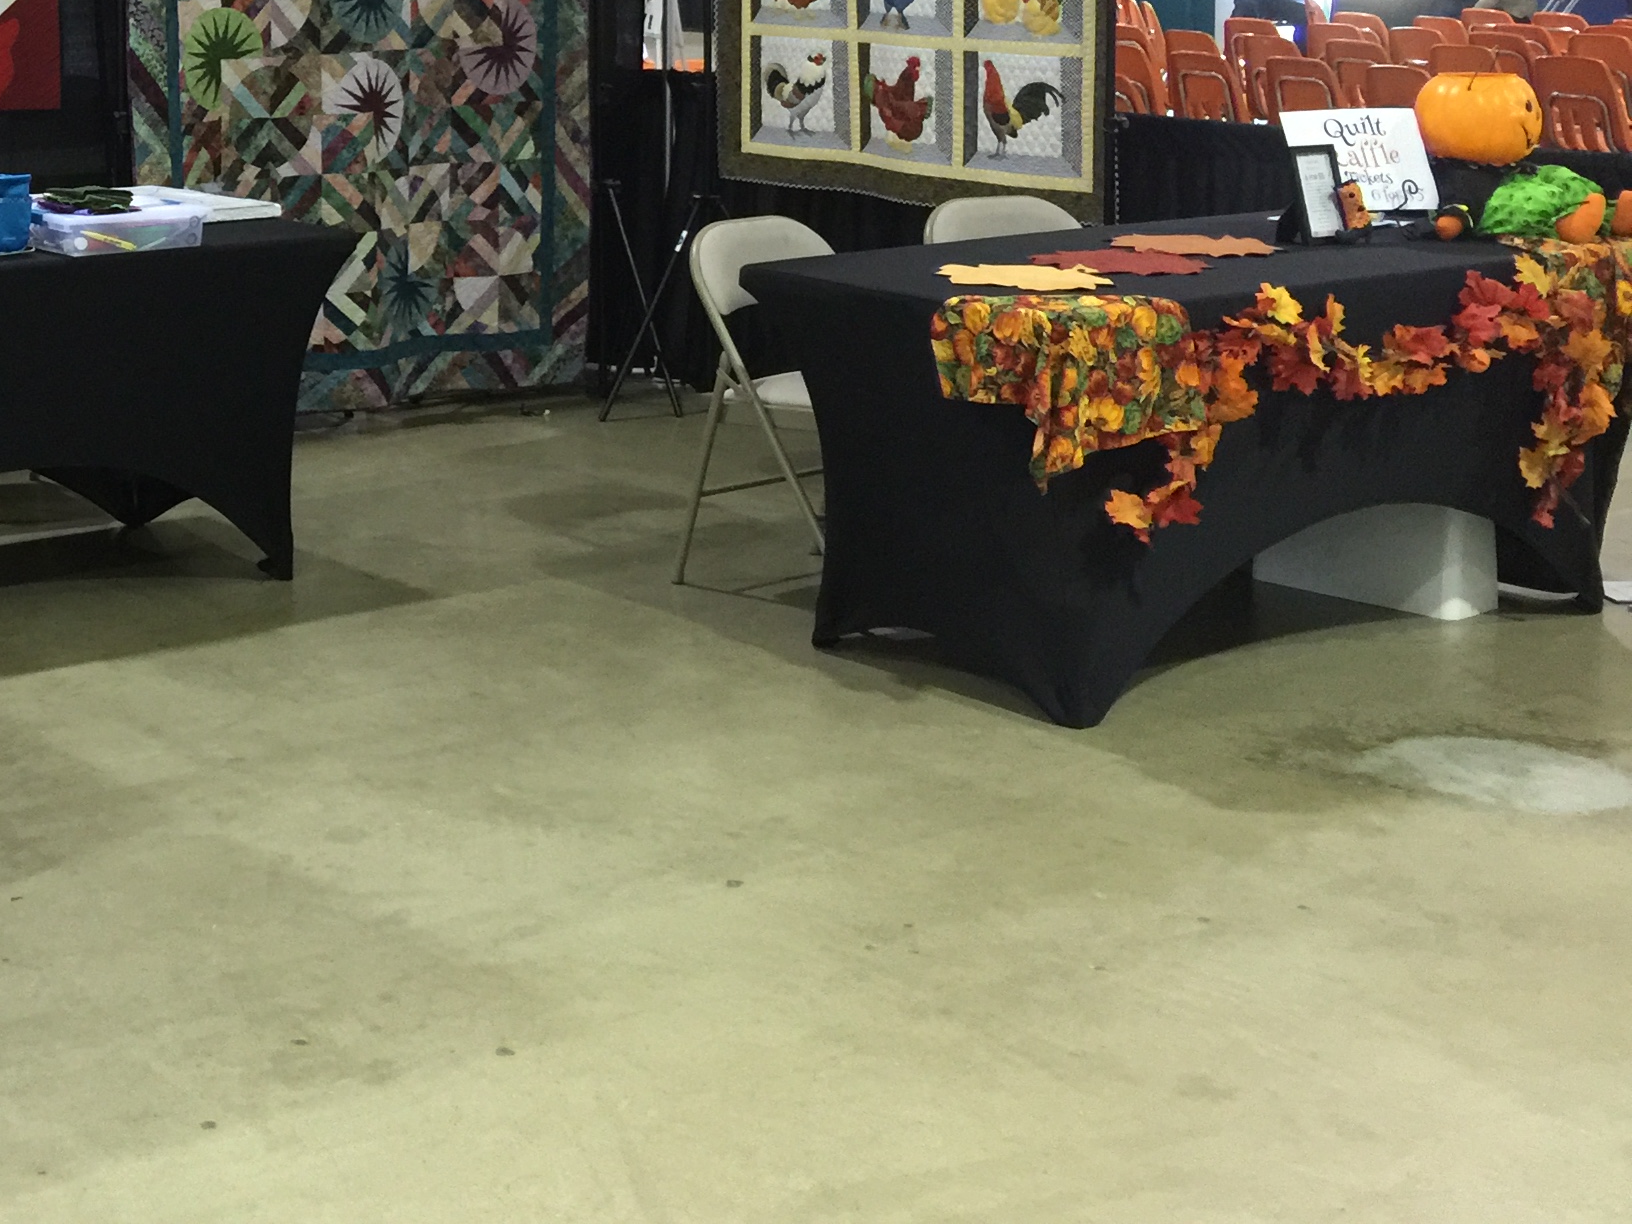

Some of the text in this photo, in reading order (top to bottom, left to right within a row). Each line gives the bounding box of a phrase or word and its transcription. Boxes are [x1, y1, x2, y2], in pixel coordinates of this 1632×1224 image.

[1323, 115, 1386, 146] Quilt
[1338, 139, 1401, 167] affle
[1343, 170, 1394, 185] Tickets
